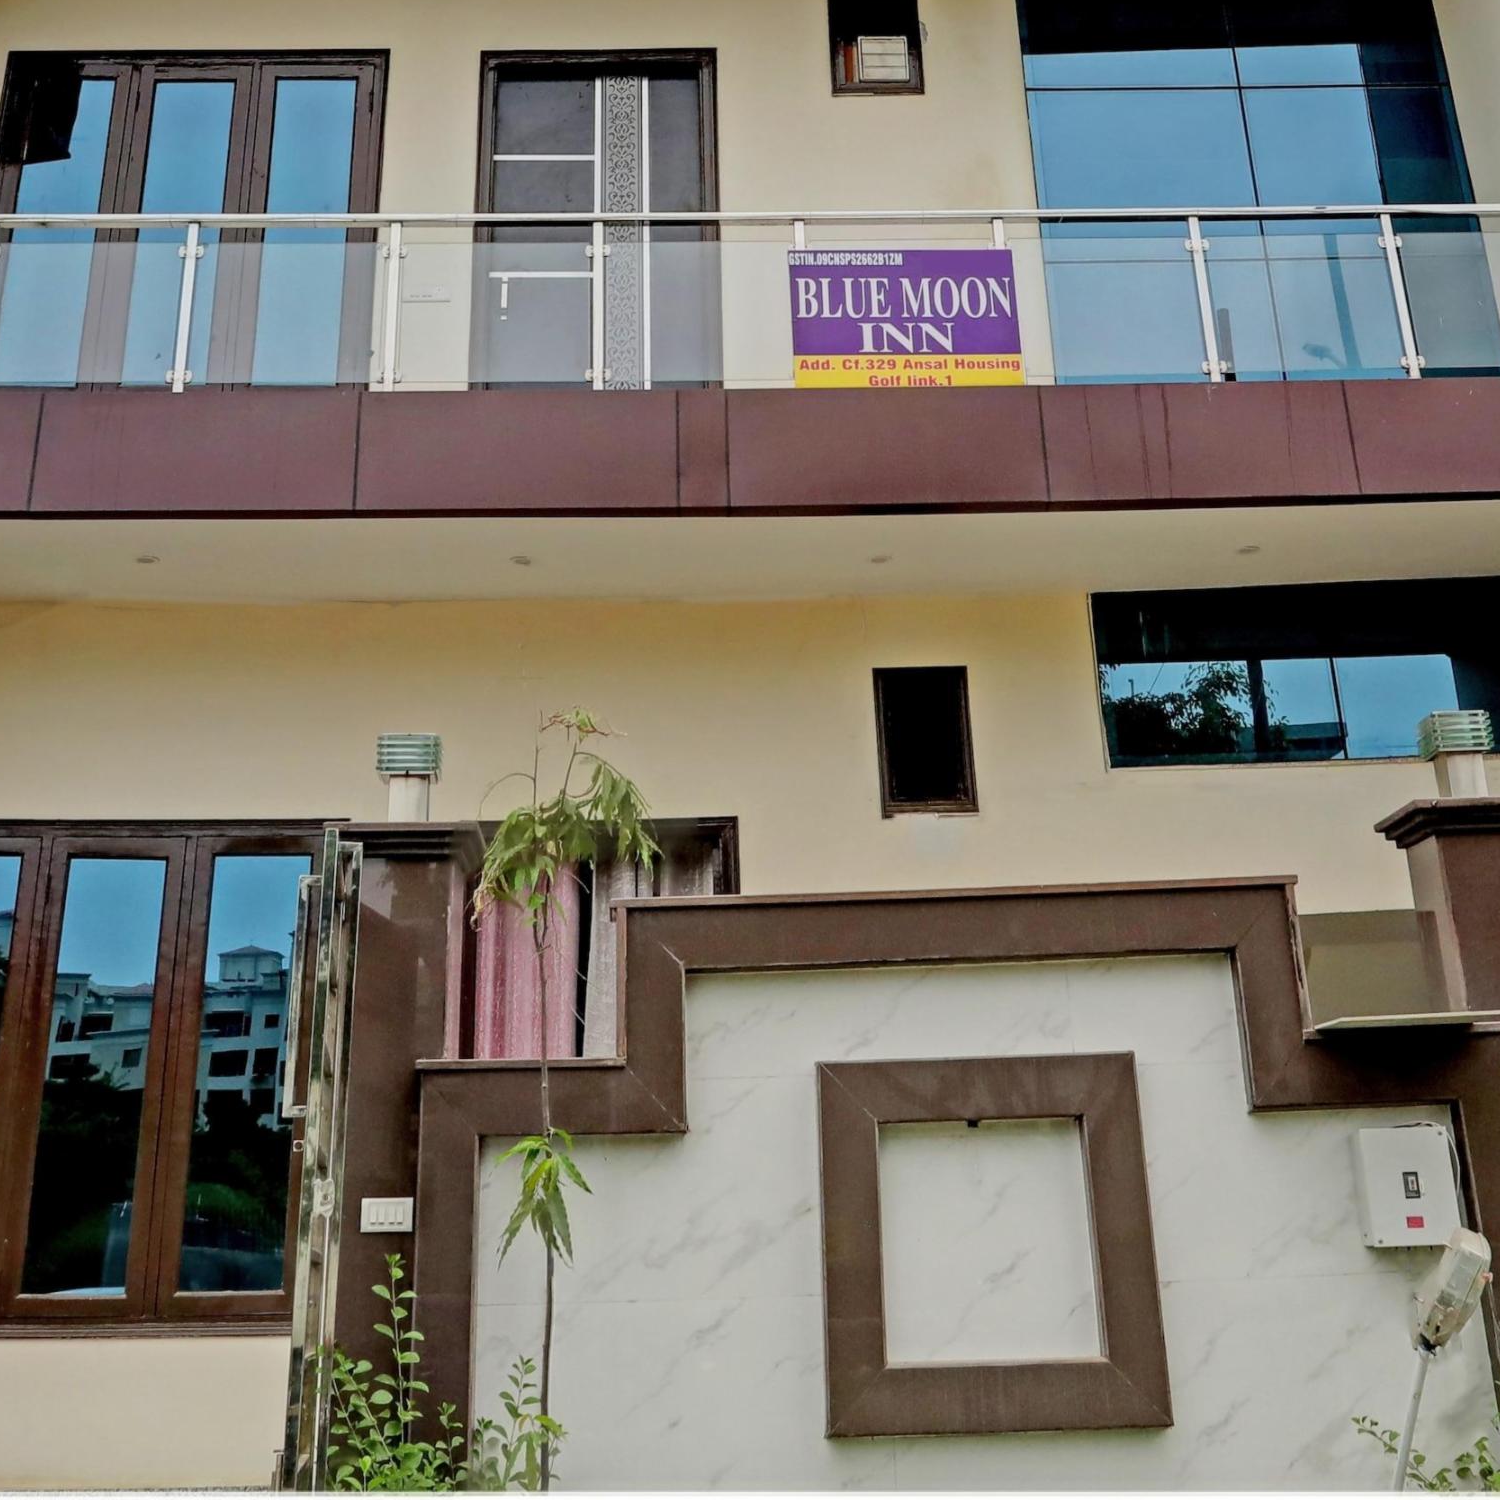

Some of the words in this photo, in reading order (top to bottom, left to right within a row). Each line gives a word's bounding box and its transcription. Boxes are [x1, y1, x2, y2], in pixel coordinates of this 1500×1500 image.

[795, 277, 891, 318] BLUE
[899, 277, 1012, 318] MOON
[857, 322, 954, 353] INN
[800, 359, 835, 370] Add.
[903, 359, 948, 369] Ansal
[955, 358, 1020, 371] Housing
[869, 375, 900, 386] Golf
[908, 375, 952, 386] link.1
